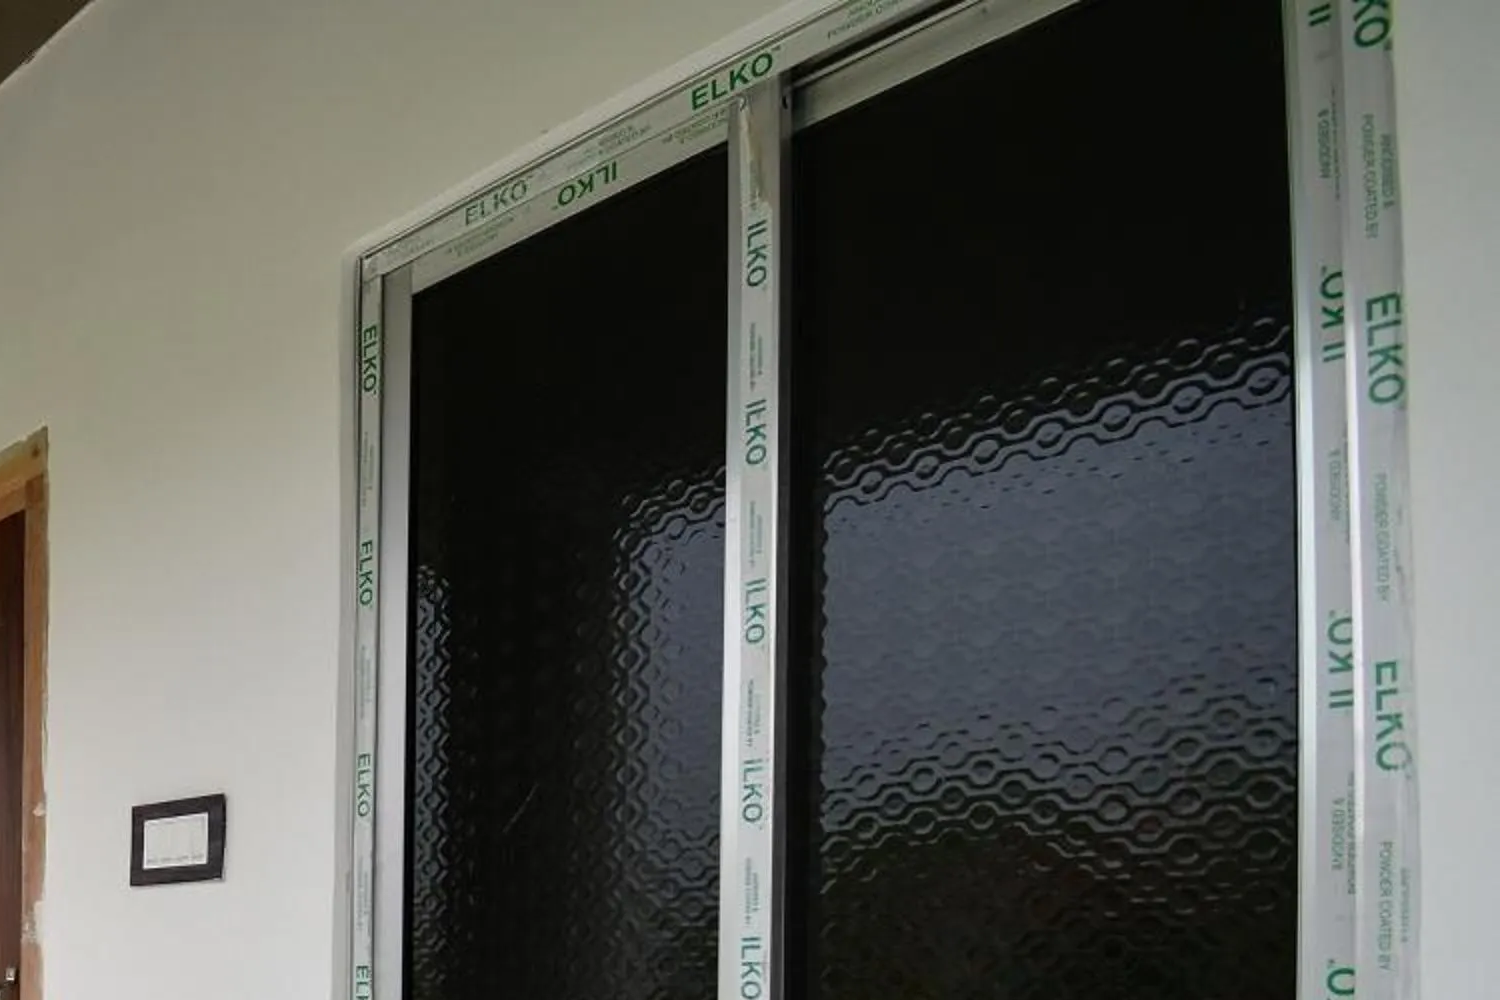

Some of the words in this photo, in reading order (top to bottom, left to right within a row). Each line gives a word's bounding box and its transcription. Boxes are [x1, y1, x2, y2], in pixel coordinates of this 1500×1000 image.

[1353, 0, 1389, 47] KO
[691, 53, 773, 110] ELKO
[464, 179, 528, 226] ELKO
[557, 161, 617, 206] ILKO
[746, 219, 767, 288] ILKO
[362, 324, 378, 393] ELKO
[1366, 291, 1404, 404] ELKO
[745, 399, 767, 466] ILKO
[745, 578, 767, 645] ILKO
[1375, 661, 1413, 772] ELKO
[357, 752, 371, 818] ELKO
[742, 758, 764, 824] ILKO
[740, 936, 762, 1000] ILKO
